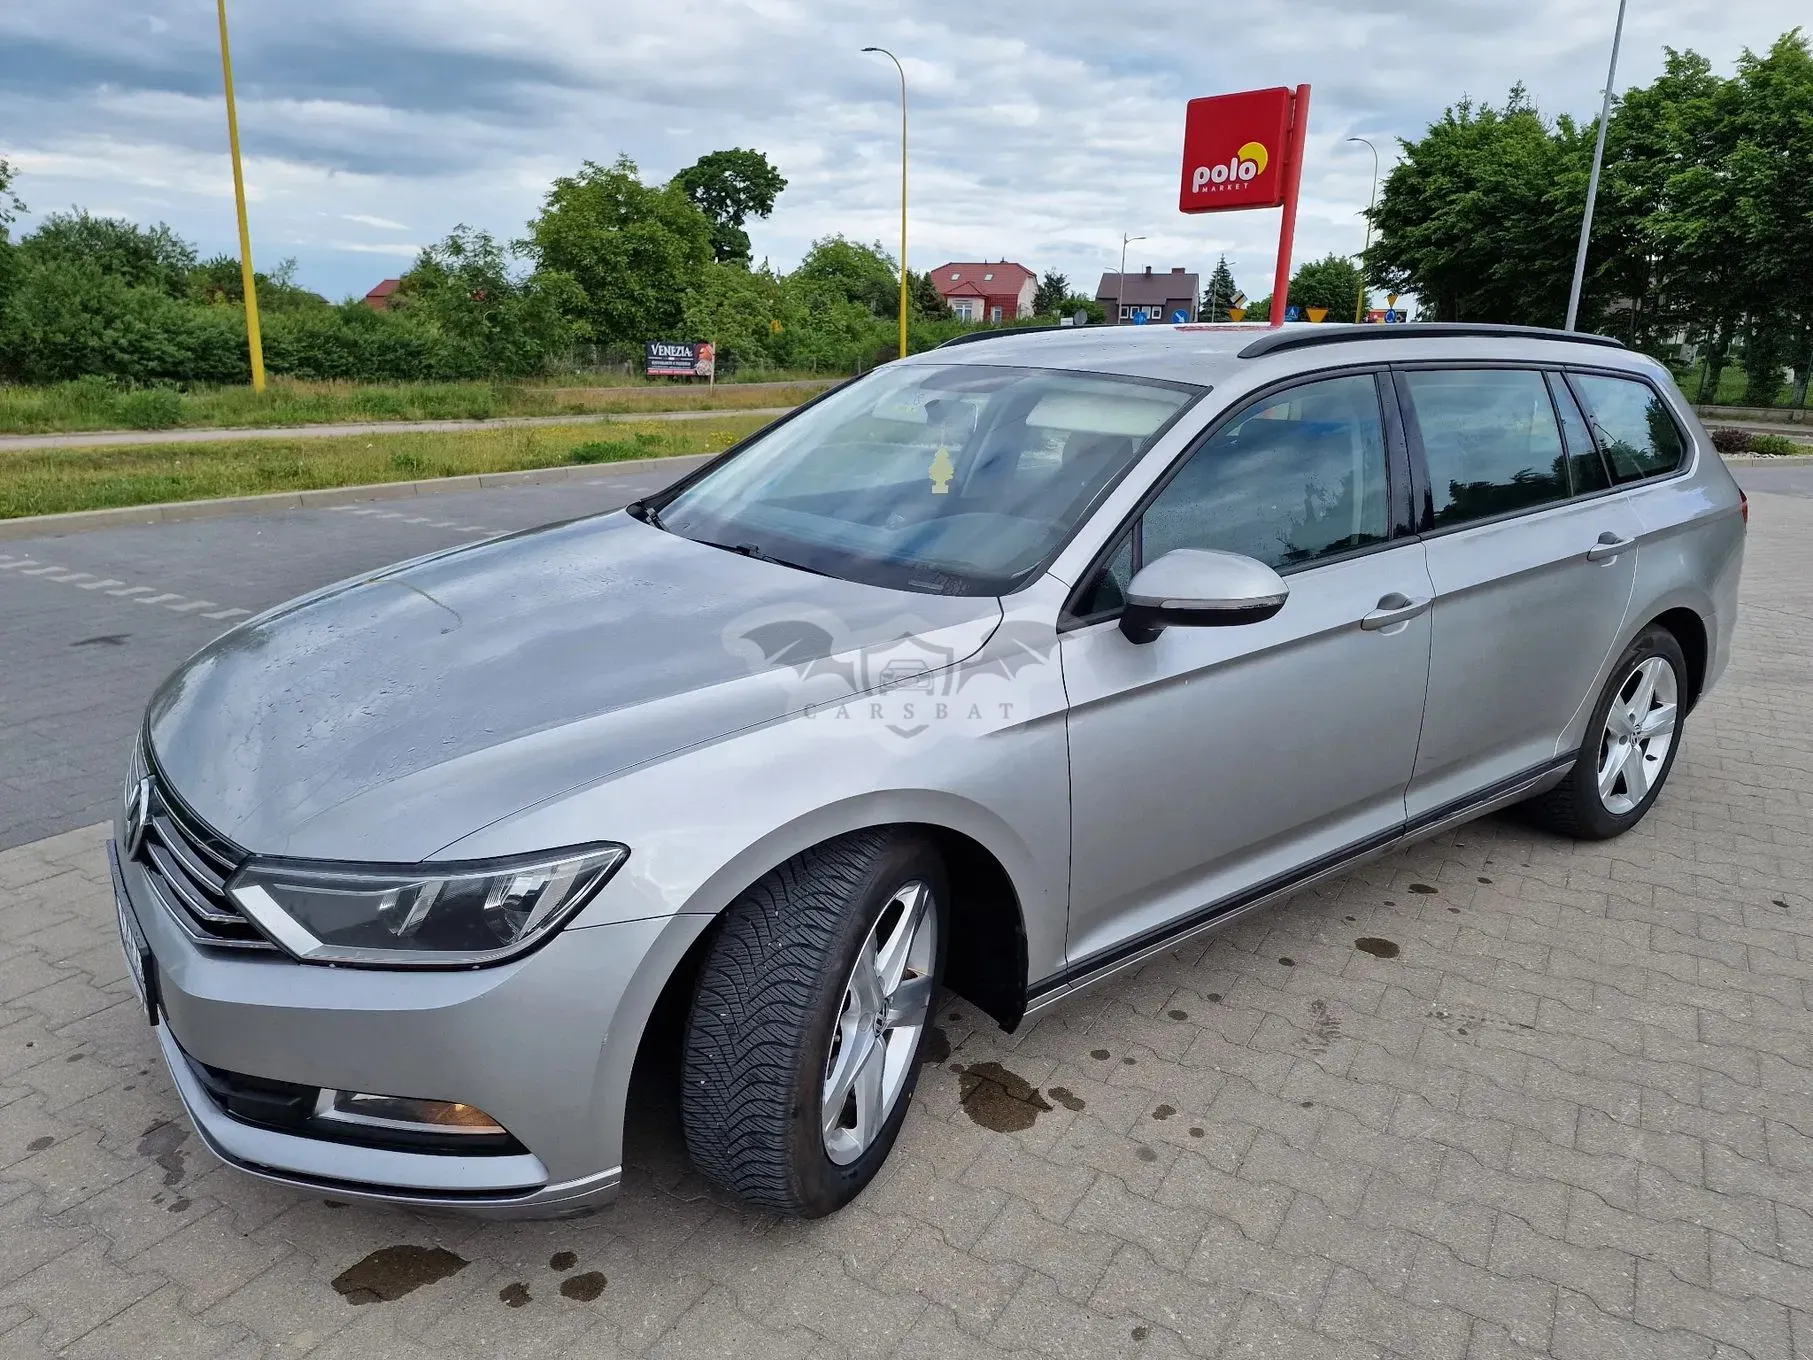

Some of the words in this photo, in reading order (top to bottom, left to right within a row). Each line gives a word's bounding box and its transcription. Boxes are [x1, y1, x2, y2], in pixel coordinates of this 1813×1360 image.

[1192, 157, 1257, 193] polo
[1202, 182, 1249, 193] MARKET
[651, 342, 692, 357] VENEZIA
